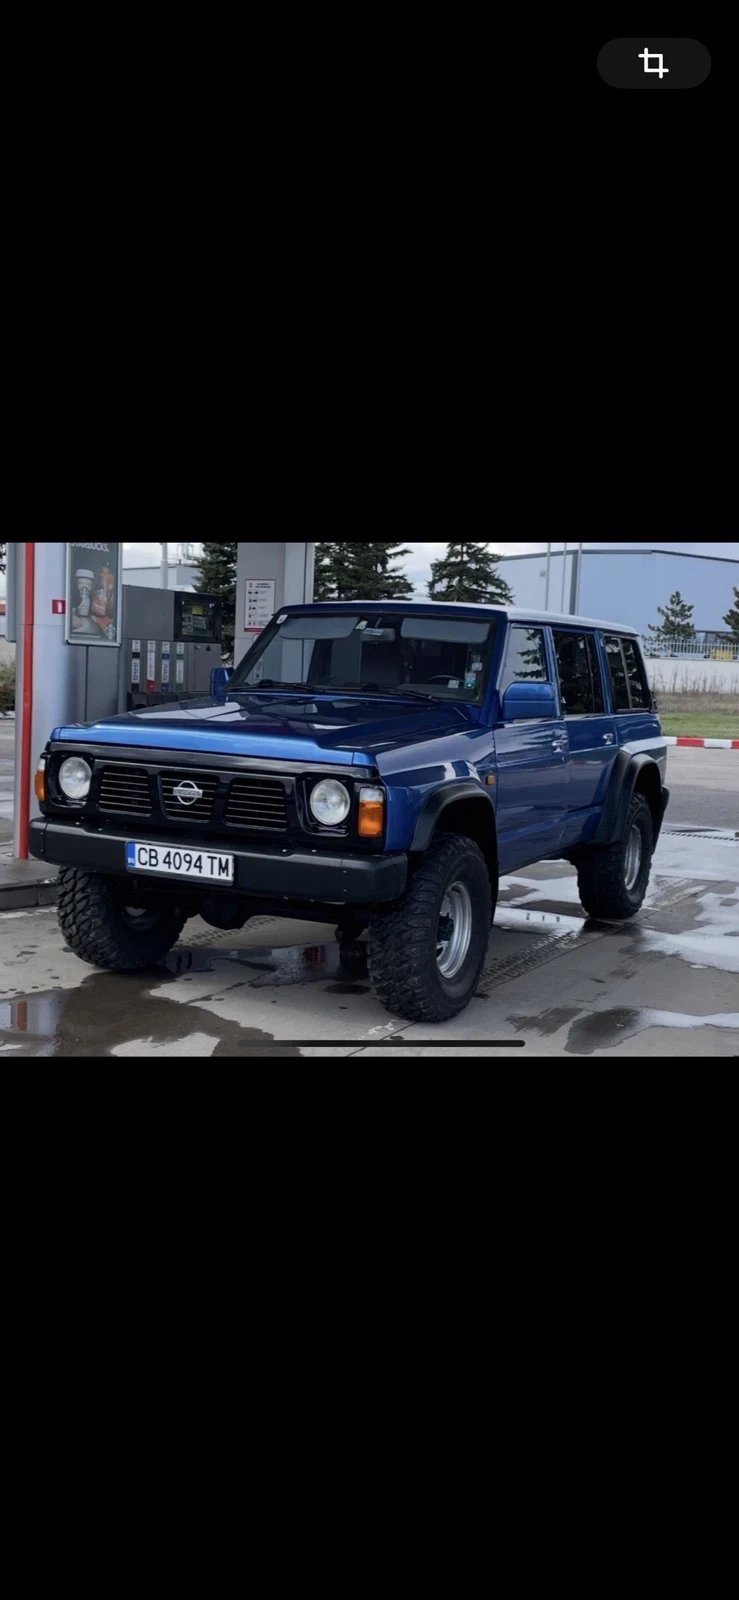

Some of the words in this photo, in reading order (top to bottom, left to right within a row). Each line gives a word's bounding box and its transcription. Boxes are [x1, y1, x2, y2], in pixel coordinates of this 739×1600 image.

[138, 847, 159, 867] CB
[163, 851, 203, 874] 4094
[207, 856, 229, 877] TM
